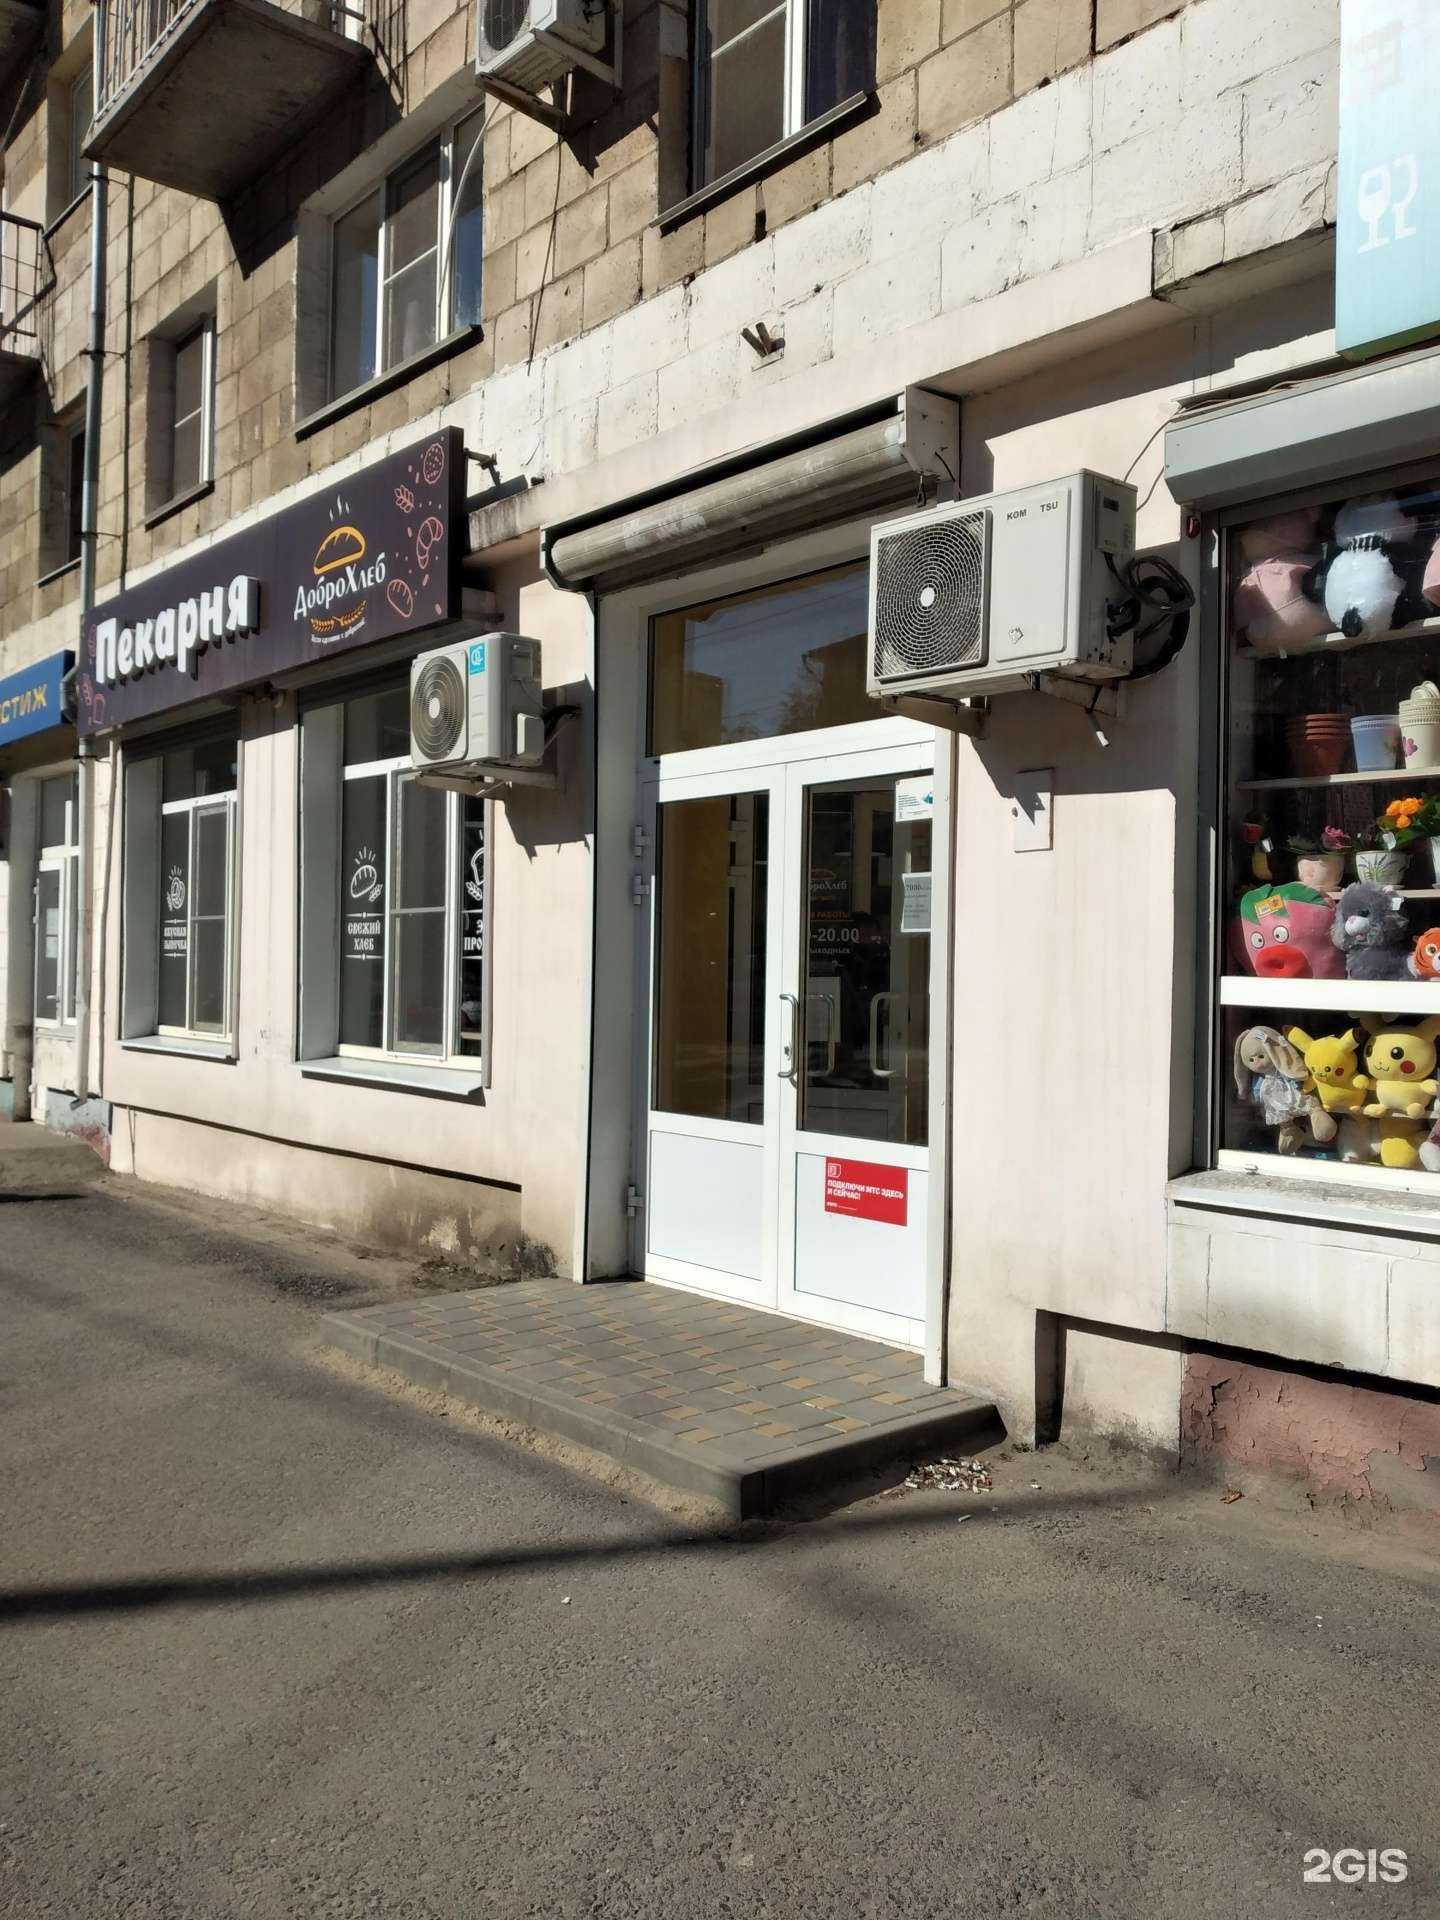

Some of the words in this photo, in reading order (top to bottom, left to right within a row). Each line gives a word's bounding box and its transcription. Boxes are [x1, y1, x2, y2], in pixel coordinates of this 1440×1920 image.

[1006, 508, 1028, 521] KOM
[1040, 501, 1059, 513] TSU
[294, 552, 386, 621] ДоброХлеб
[95, 574, 250, 684] Пекарня
[0, 683, 47, 725] СТИЖ
[347, 919, 381, 934] СВЕЖИЙ
[353, 938, 375, 950] ХЛЕБ
[464, 936, 482, 950] ПРО
[811, 928, 860, 943] -20.00
[827, 1179, 865, 1192] ПОДКЛЮЧИ
[865, 1186, 881, 1195] МТС
[881, 1188, 904, 1199] ЗДЕСЬ
[827, 1187, 833, 1195] И
